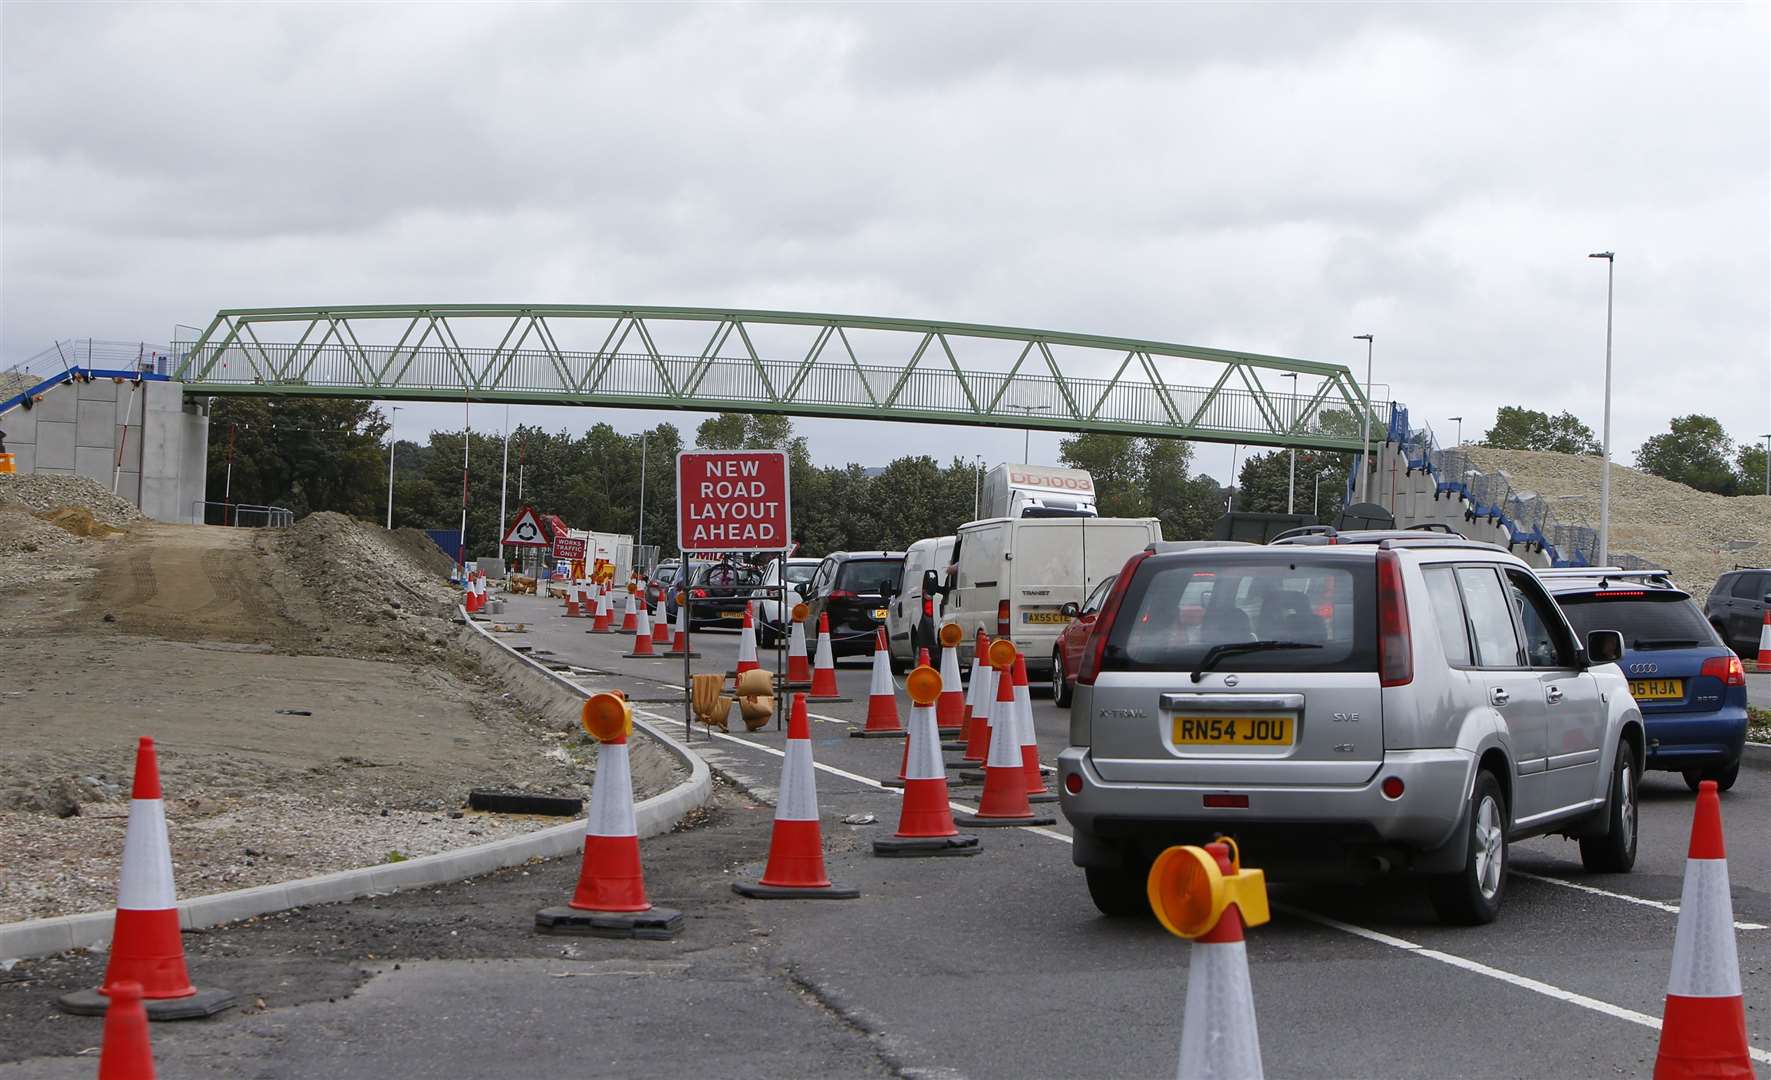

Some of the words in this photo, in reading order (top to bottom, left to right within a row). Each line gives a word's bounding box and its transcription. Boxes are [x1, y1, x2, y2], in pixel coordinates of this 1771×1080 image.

[706, 460, 759, 477] NEW
[700, 481, 766, 498] ROAD
[1009, 471, 1093, 493] DD1003
[690, 502, 779, 519] LAYOUT
[693, 523, 774, 540] AHEAD
[556, 544, 582, 552] TRAFFIC
[558, 538, 582, 547] WORKS
[1028, 613, 1052, 622] AX55
[1650, 681, 1676, 695] HJA
[1333, 712, 1360, 722] SVE
[1181, 720, 1236, 741] RN54
[1243, 721, 1284, 740] JOU
